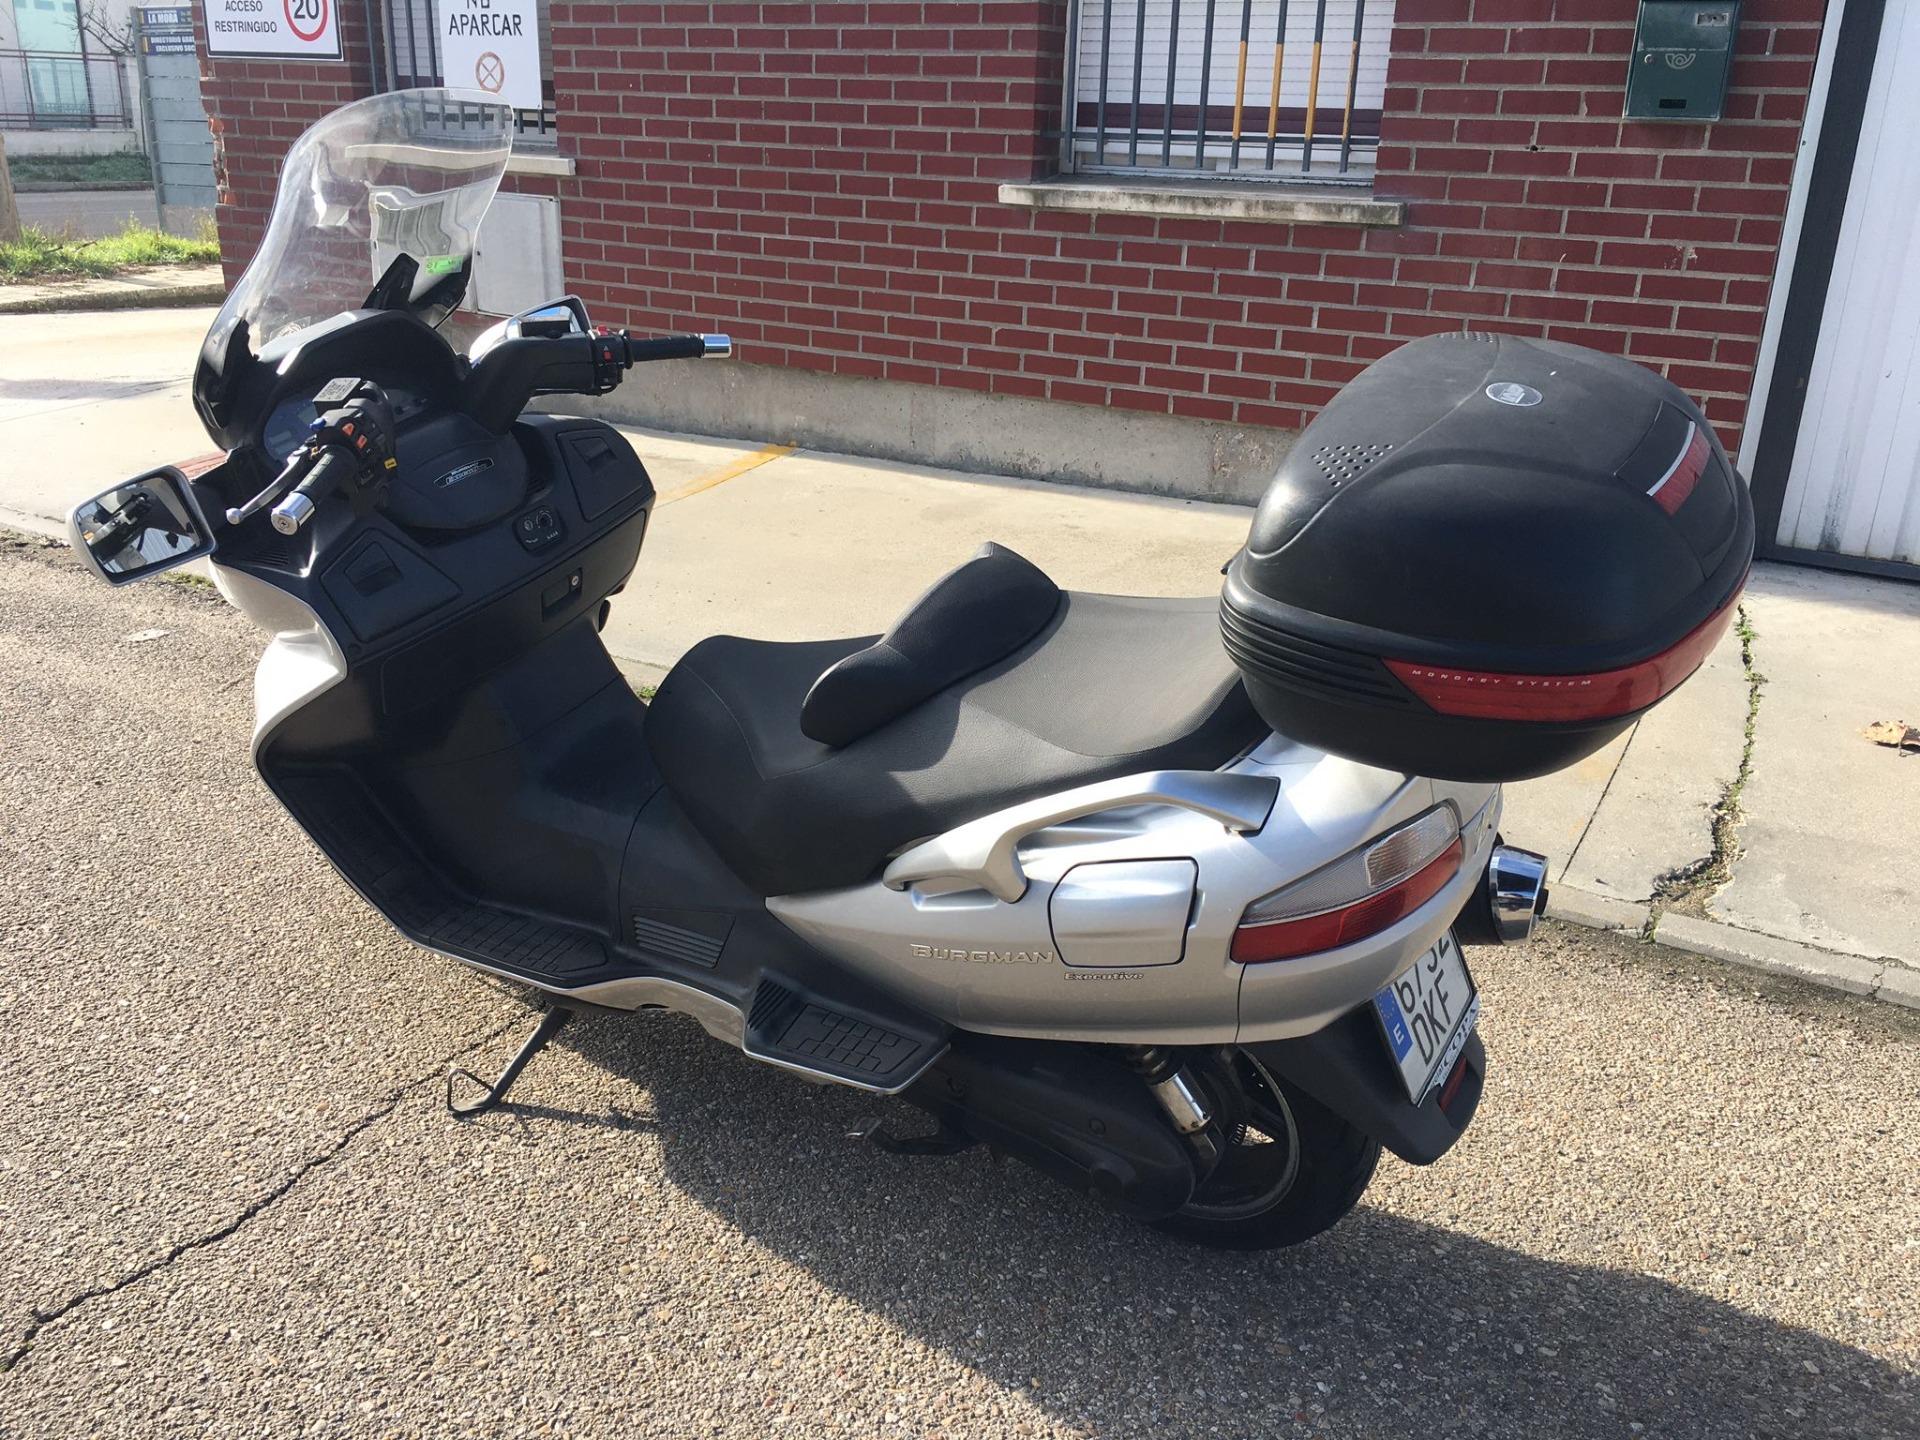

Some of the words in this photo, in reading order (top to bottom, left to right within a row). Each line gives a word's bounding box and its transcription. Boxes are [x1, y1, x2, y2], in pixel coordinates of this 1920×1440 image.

[225, 0, 263, 12] ACCESO
[292, 0, 320, 20] 20
[215, 20, 278, 33] RESTRINGIDO
[449, 13, 523, 37] APARCAR
[1411, 669, 1501, 684] MONOKEY
[1516, 679, 1592, 688] SYSTEM
[909, 943, 1055, 965] BURGMAN
[1063, 971, 1144, 981] Executive
[1410, 968, 1451, 1068] DKF
[1392, 1022, 1405, 1046] E
